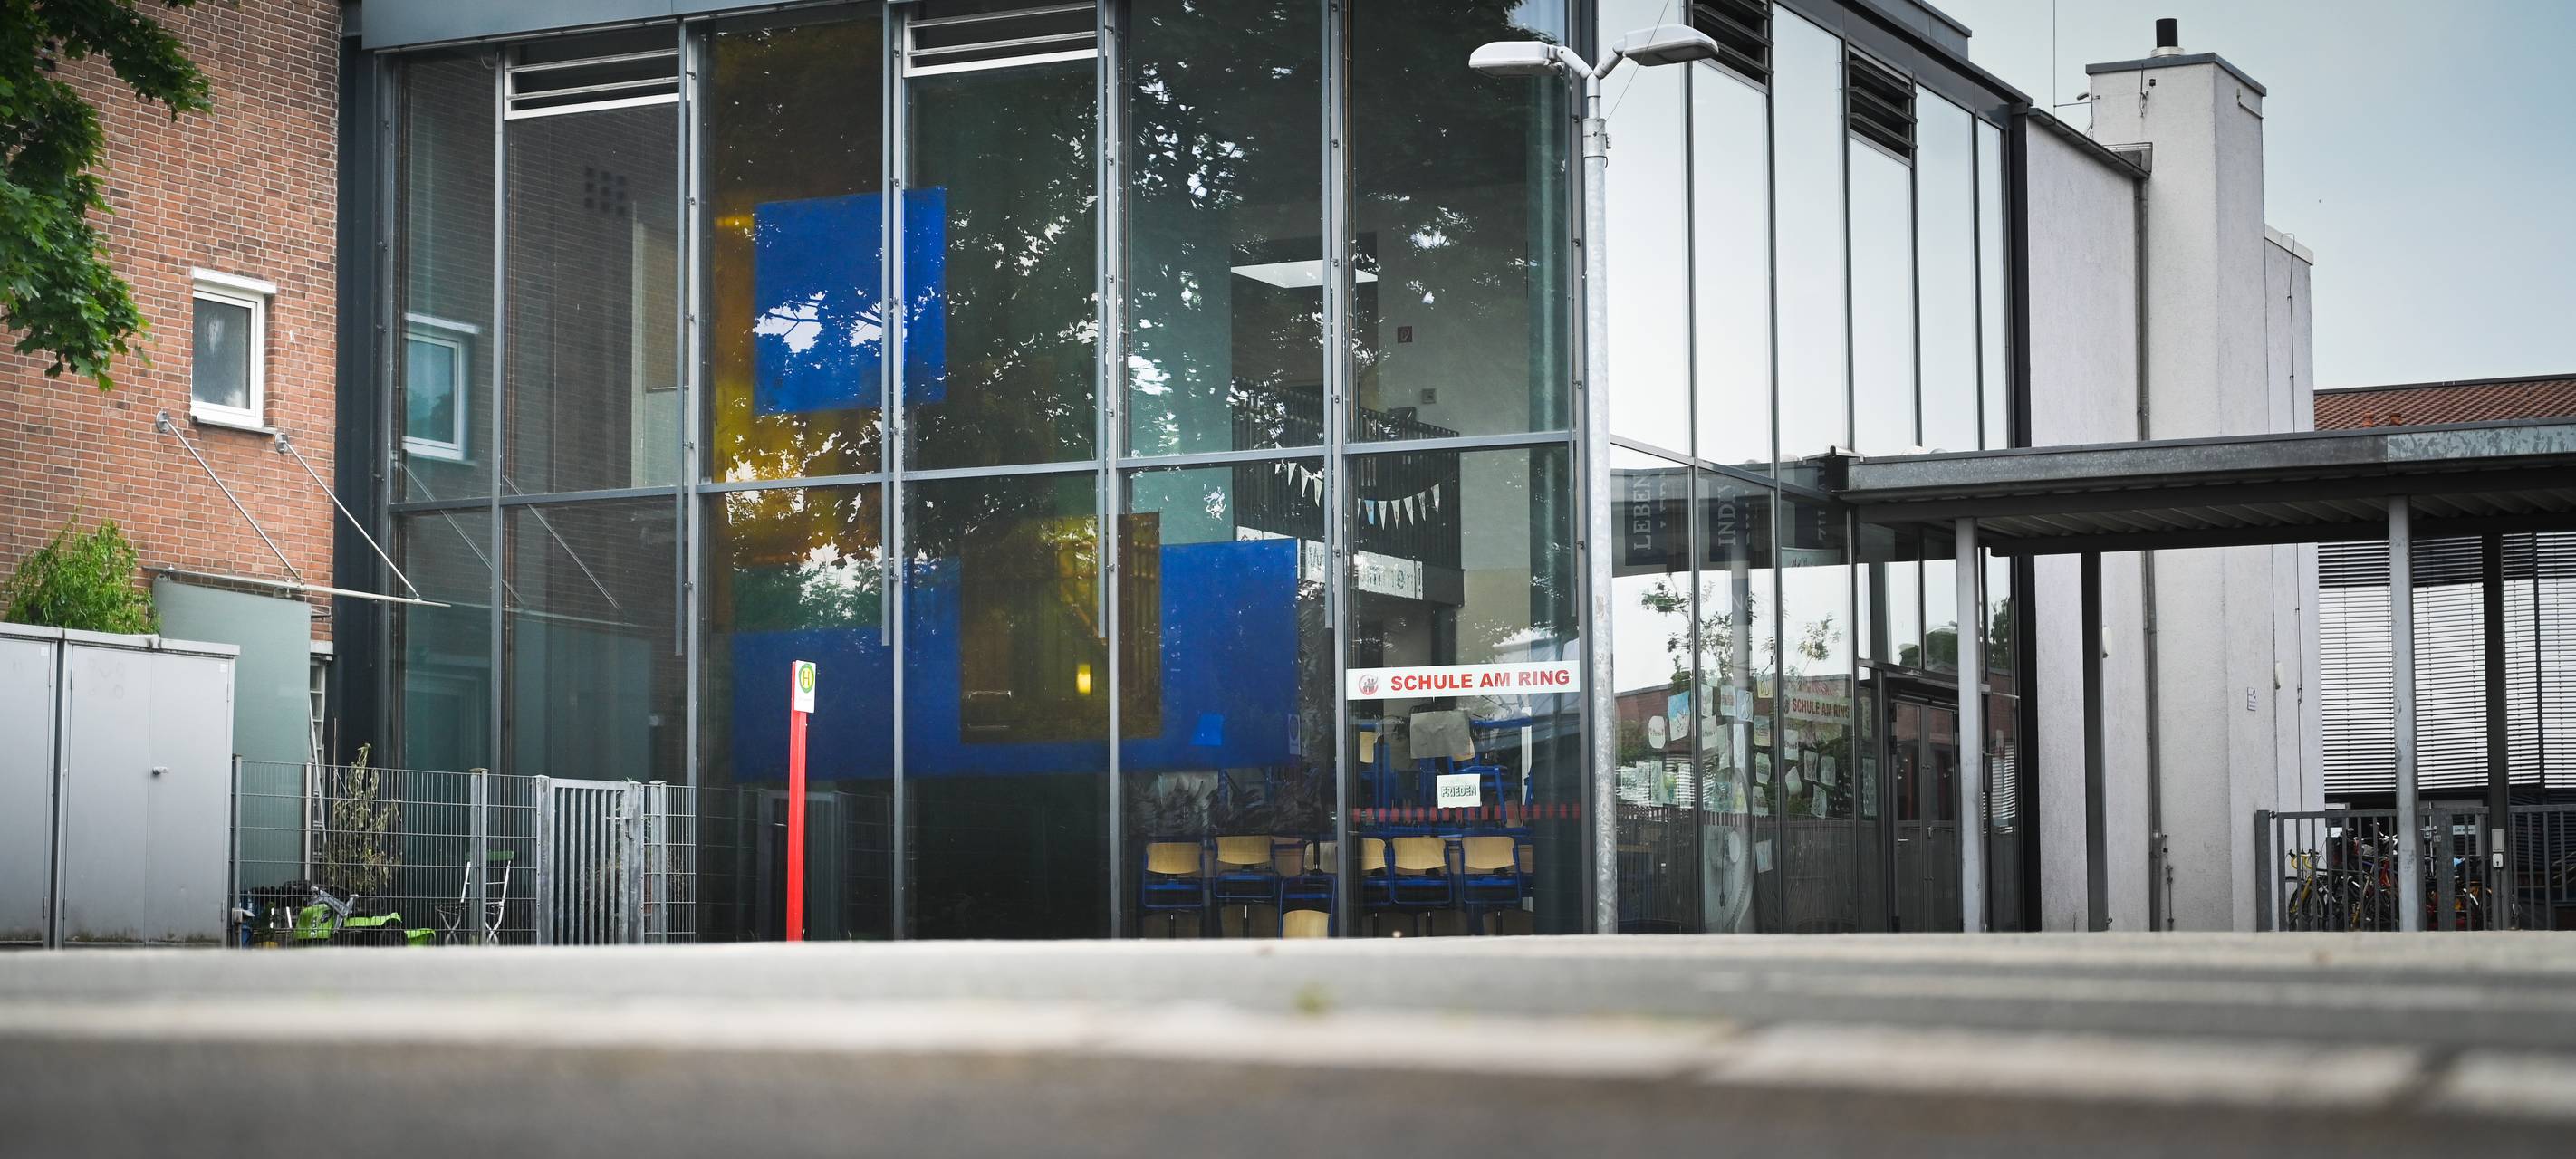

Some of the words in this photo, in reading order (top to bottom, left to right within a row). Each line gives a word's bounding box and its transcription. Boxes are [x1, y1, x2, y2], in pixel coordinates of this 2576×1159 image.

[1390, 673, 1473, 692] SCHULE
[1479, 671, 1511, 688] AM
[1518, 669, 1571, 686] RING
[1793, 698, 1820, 715] SCHULE
[1821, 702, 1832, 717] AM
[1440, 784, 1477, 798] FRIEDEN
